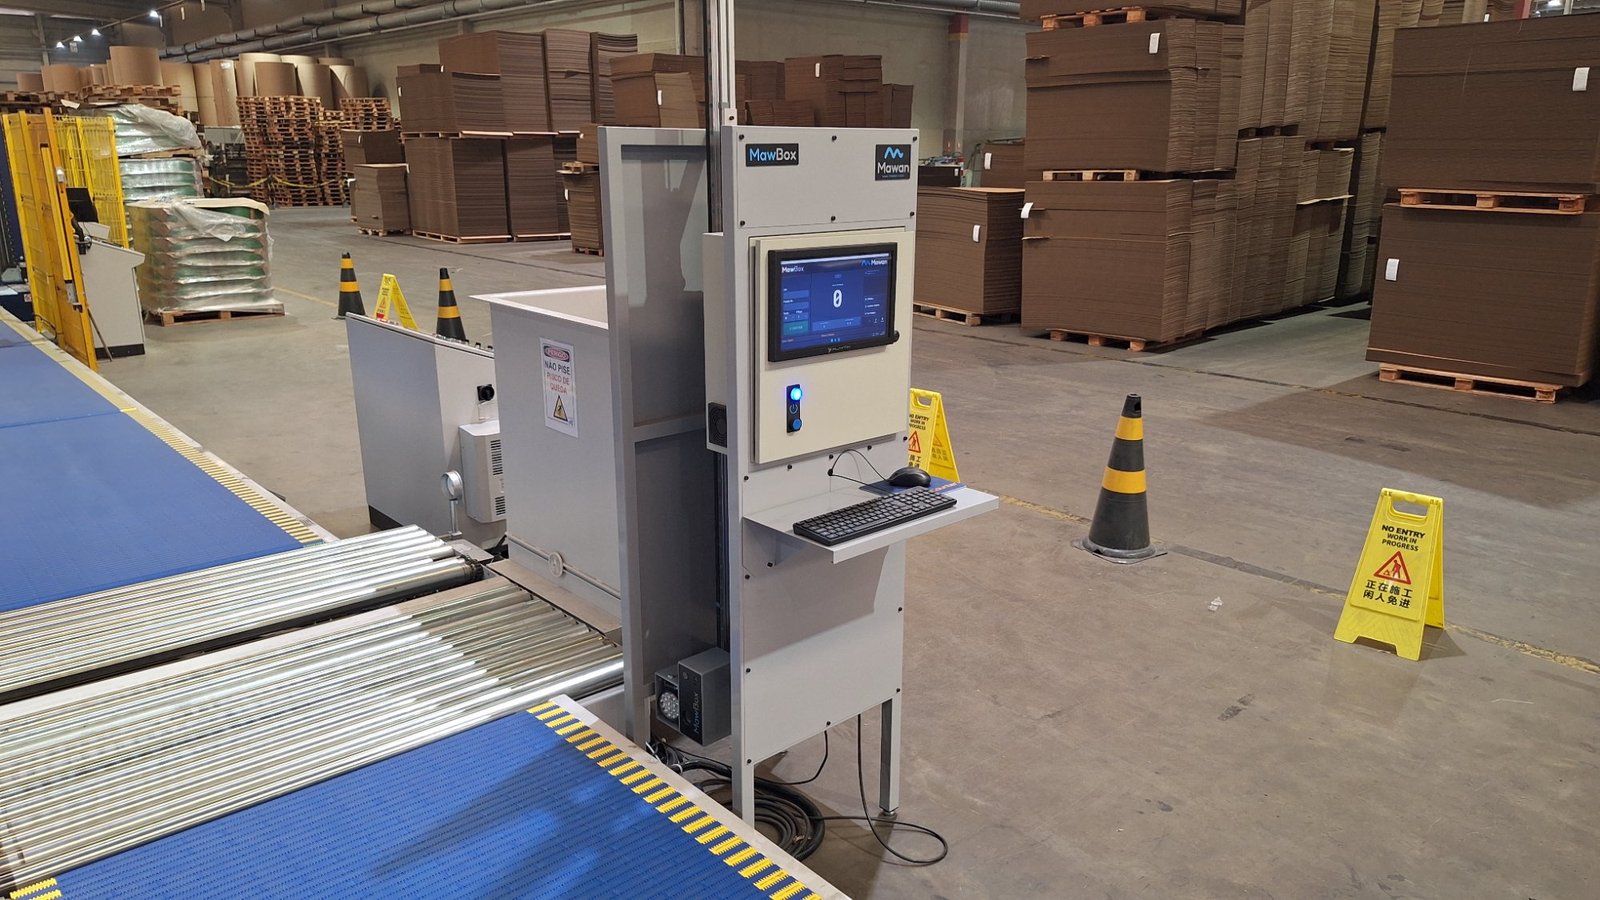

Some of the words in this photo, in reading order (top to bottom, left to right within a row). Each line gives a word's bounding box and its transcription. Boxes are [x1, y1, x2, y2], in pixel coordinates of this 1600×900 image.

[749, 148, 797, 161] MawBox
[877, 162, 910, 174] Mawan
[781, 265, 804, 273] MawBox
[833, 289, 843, 308] 0
[557, 364, 571, 375] PISE
[562, 376, 570, 386] DE
[551, 384, 567, 395] QUEDA
[1381, 525, 1394, 533] NO
[1396, 527, 1426, 539] ENTRY
[1387, 533, 1409, 543] WORK
[1409, 536, 1417, 544] IN
[1382, 539, 1419, 552] PROGRESS
[1366, 580, 1412, 599] 正在施工
[1363, 589, 1410, 609] 闲人免进
